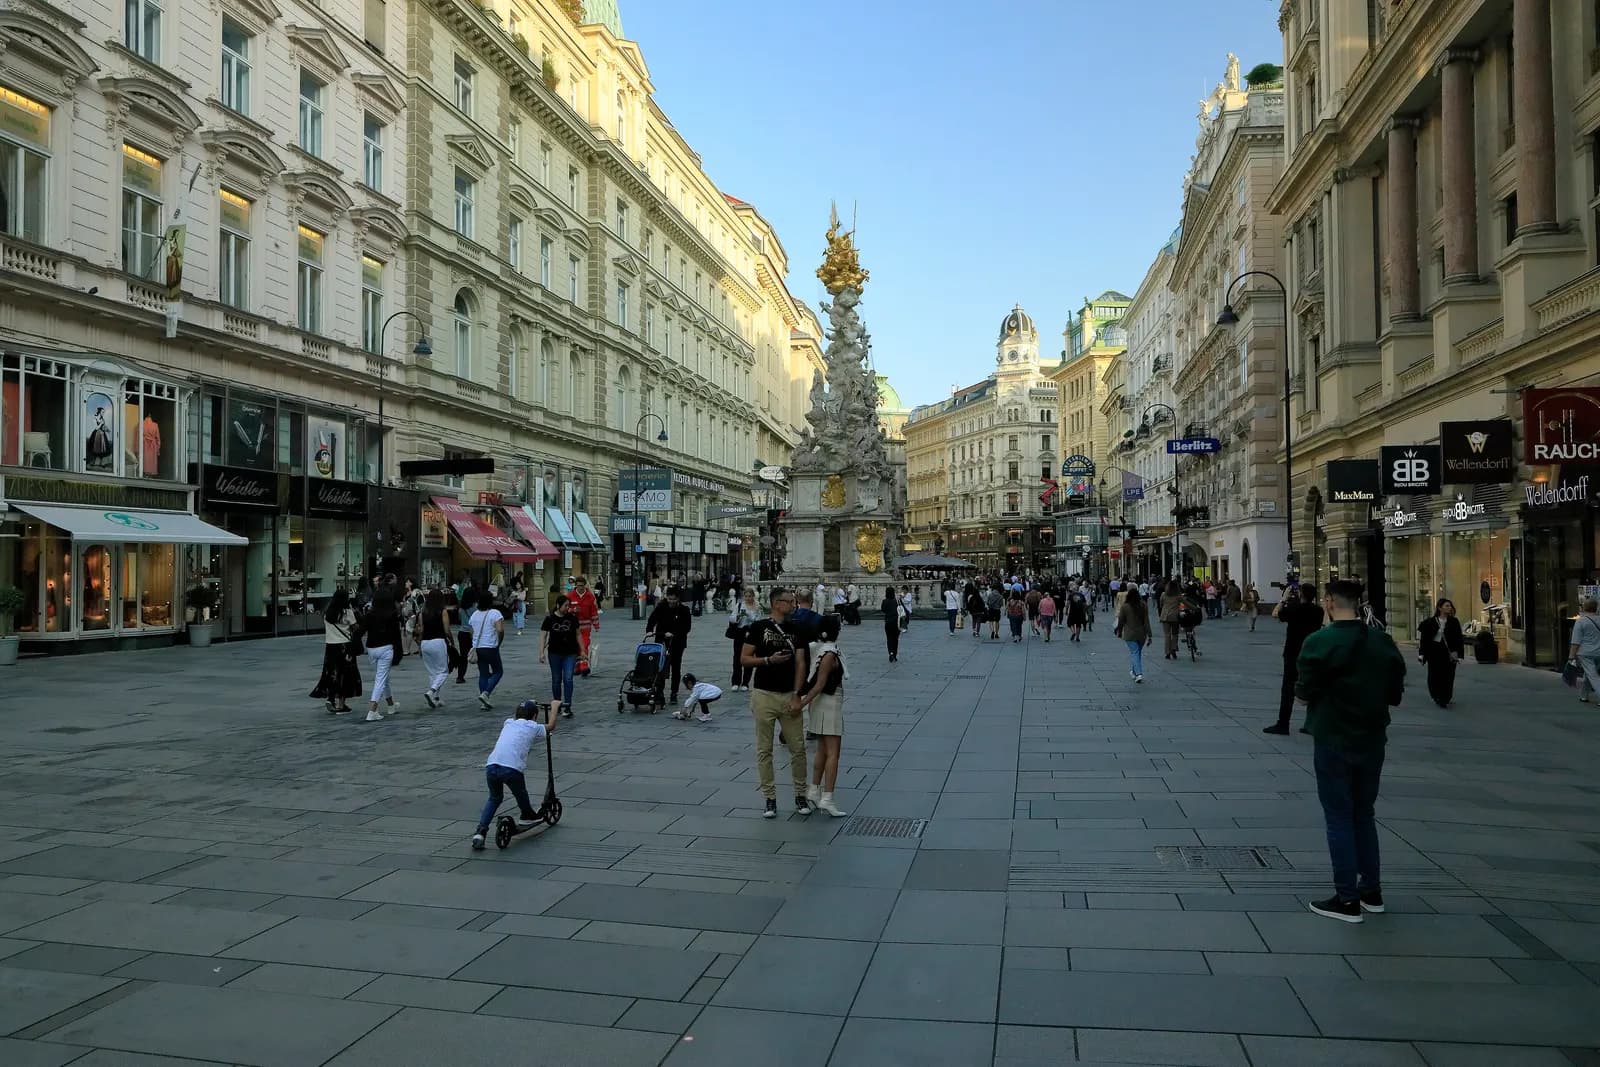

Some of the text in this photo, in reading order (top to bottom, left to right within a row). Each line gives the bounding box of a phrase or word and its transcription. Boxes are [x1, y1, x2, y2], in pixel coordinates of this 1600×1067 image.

[1172, 440, 1213, 451] Berlitz
[1446, 456, 1510, 471] Wellendorff
[215, 472, 269, 497] Weidler
[1525, 475, 1589, 507] Wellendorff
[318, 483, 361, 505] Weidler
[1334, 490, 1374, 500] MaxMara
